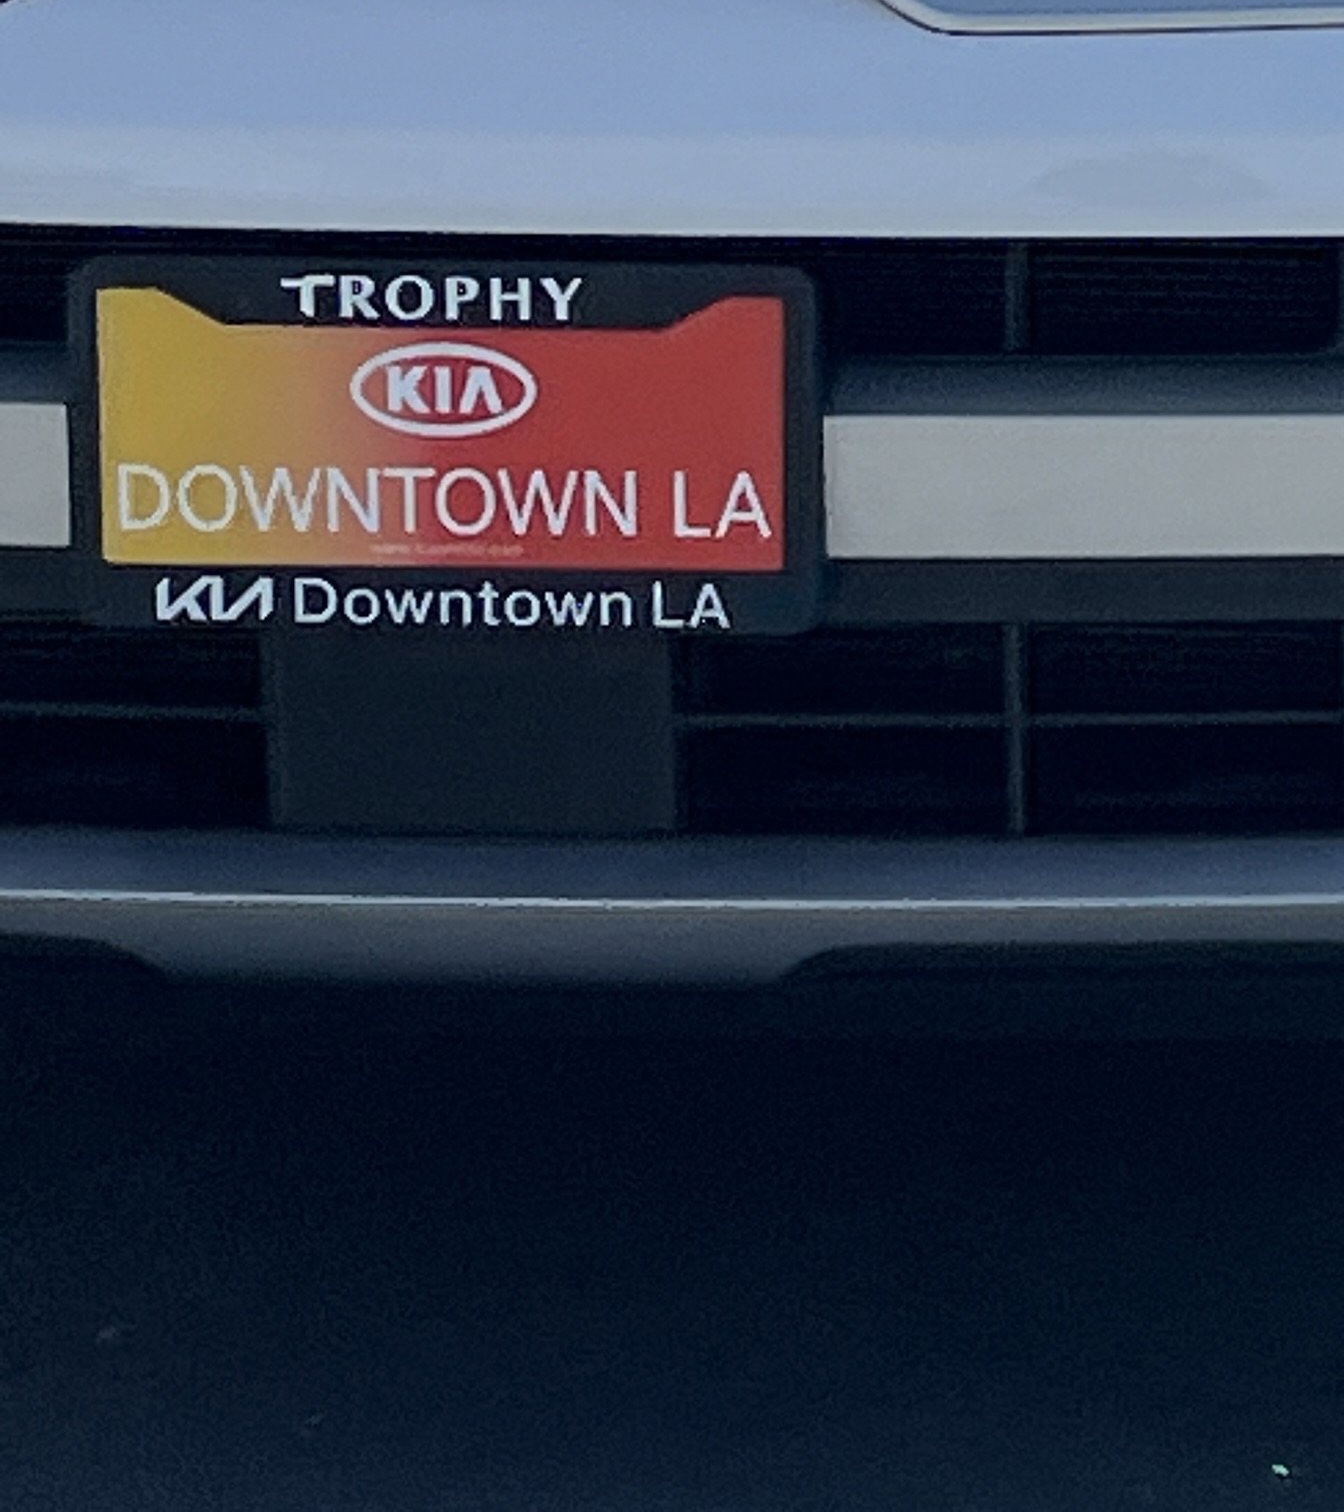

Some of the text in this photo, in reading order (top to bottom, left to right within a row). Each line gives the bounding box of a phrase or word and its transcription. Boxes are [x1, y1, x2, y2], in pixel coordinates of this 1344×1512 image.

[280, 273, 583, 322] TROPHY
[385, 365, 503, 415] KIA
[115, 463, 772, 539] DOWNTOWN LA
[156, 574, 731, 629] KIA Downtown LA
